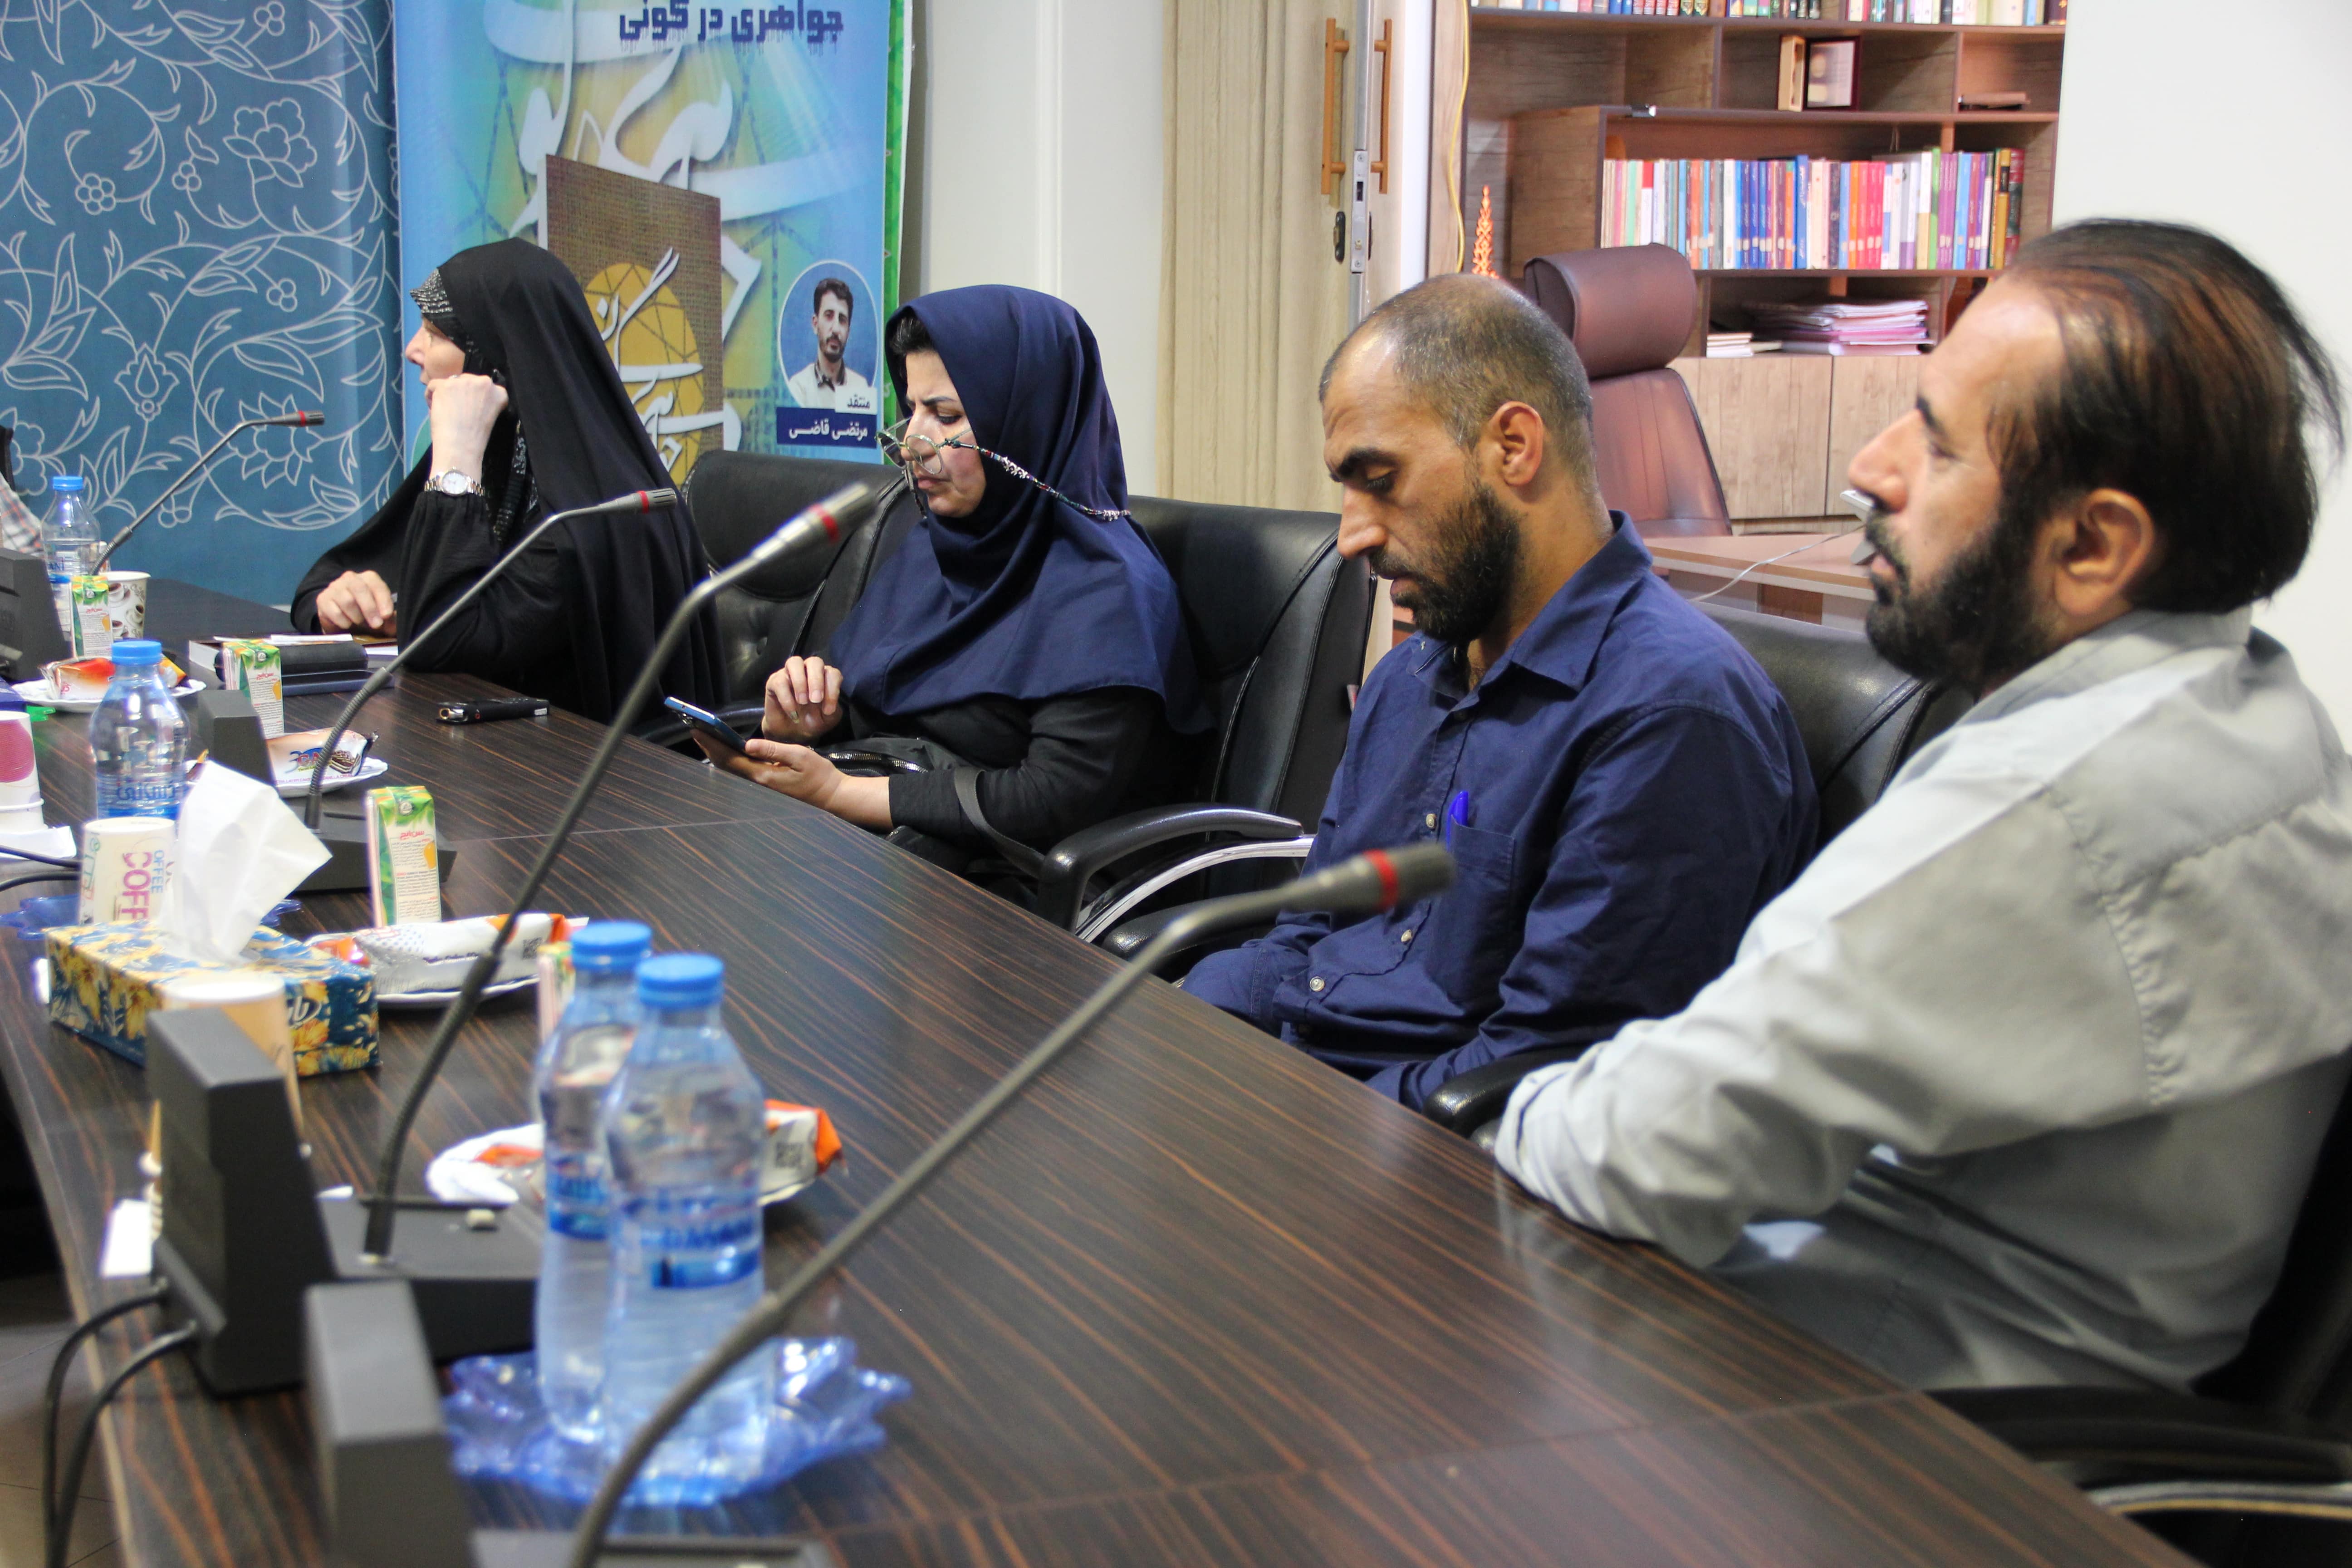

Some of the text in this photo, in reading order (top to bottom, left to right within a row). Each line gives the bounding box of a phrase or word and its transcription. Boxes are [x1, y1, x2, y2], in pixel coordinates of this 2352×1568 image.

[698, 8, 723, 45] در
[731, 0, 843, 48] جواهری
[847, 394, 871, 409] منتقد
[789, 418, 868, 441] مرتضی قاضی
